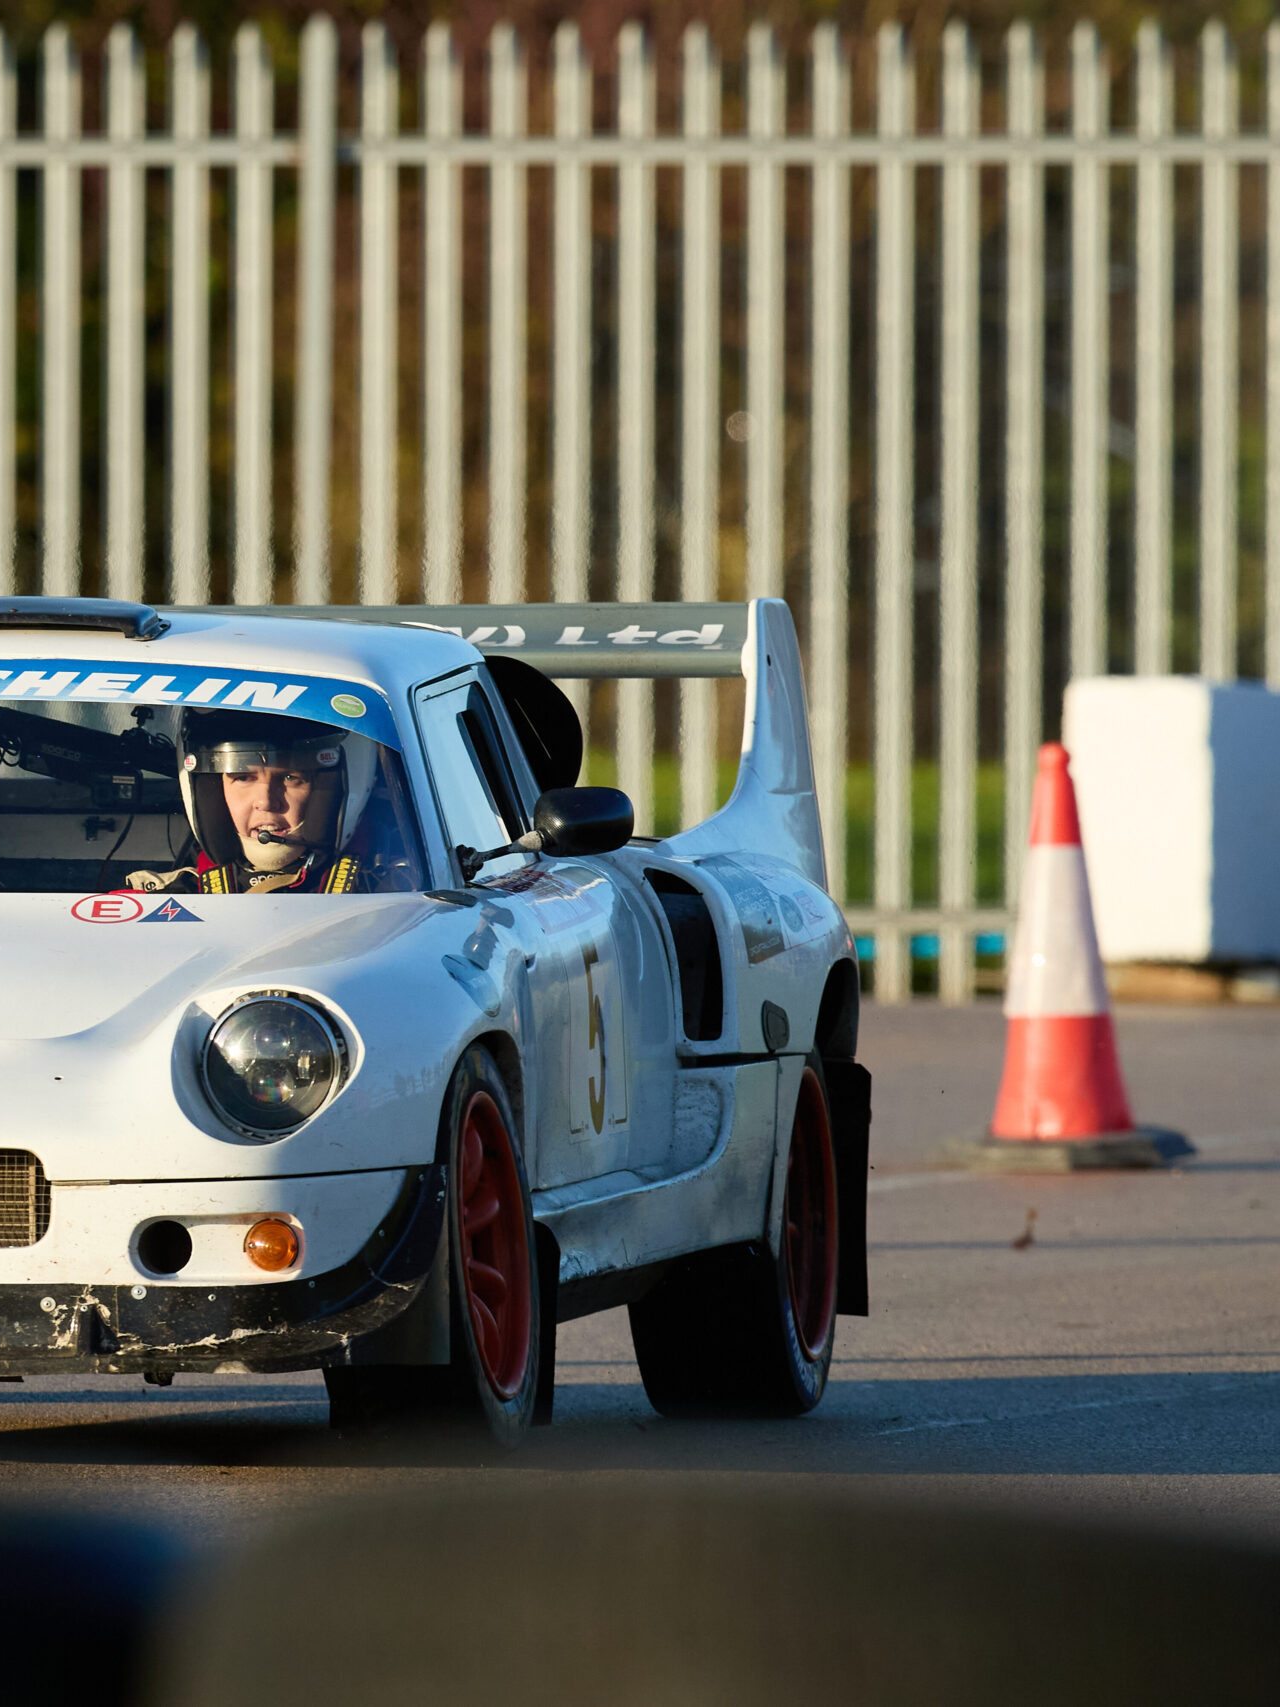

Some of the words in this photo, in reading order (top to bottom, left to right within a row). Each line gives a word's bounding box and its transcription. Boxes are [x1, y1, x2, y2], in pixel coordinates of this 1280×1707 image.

[554, 624, 724, 650] Ltd
[91, 900, 123, 918] E
[577, 928, 607, 1135] 5
